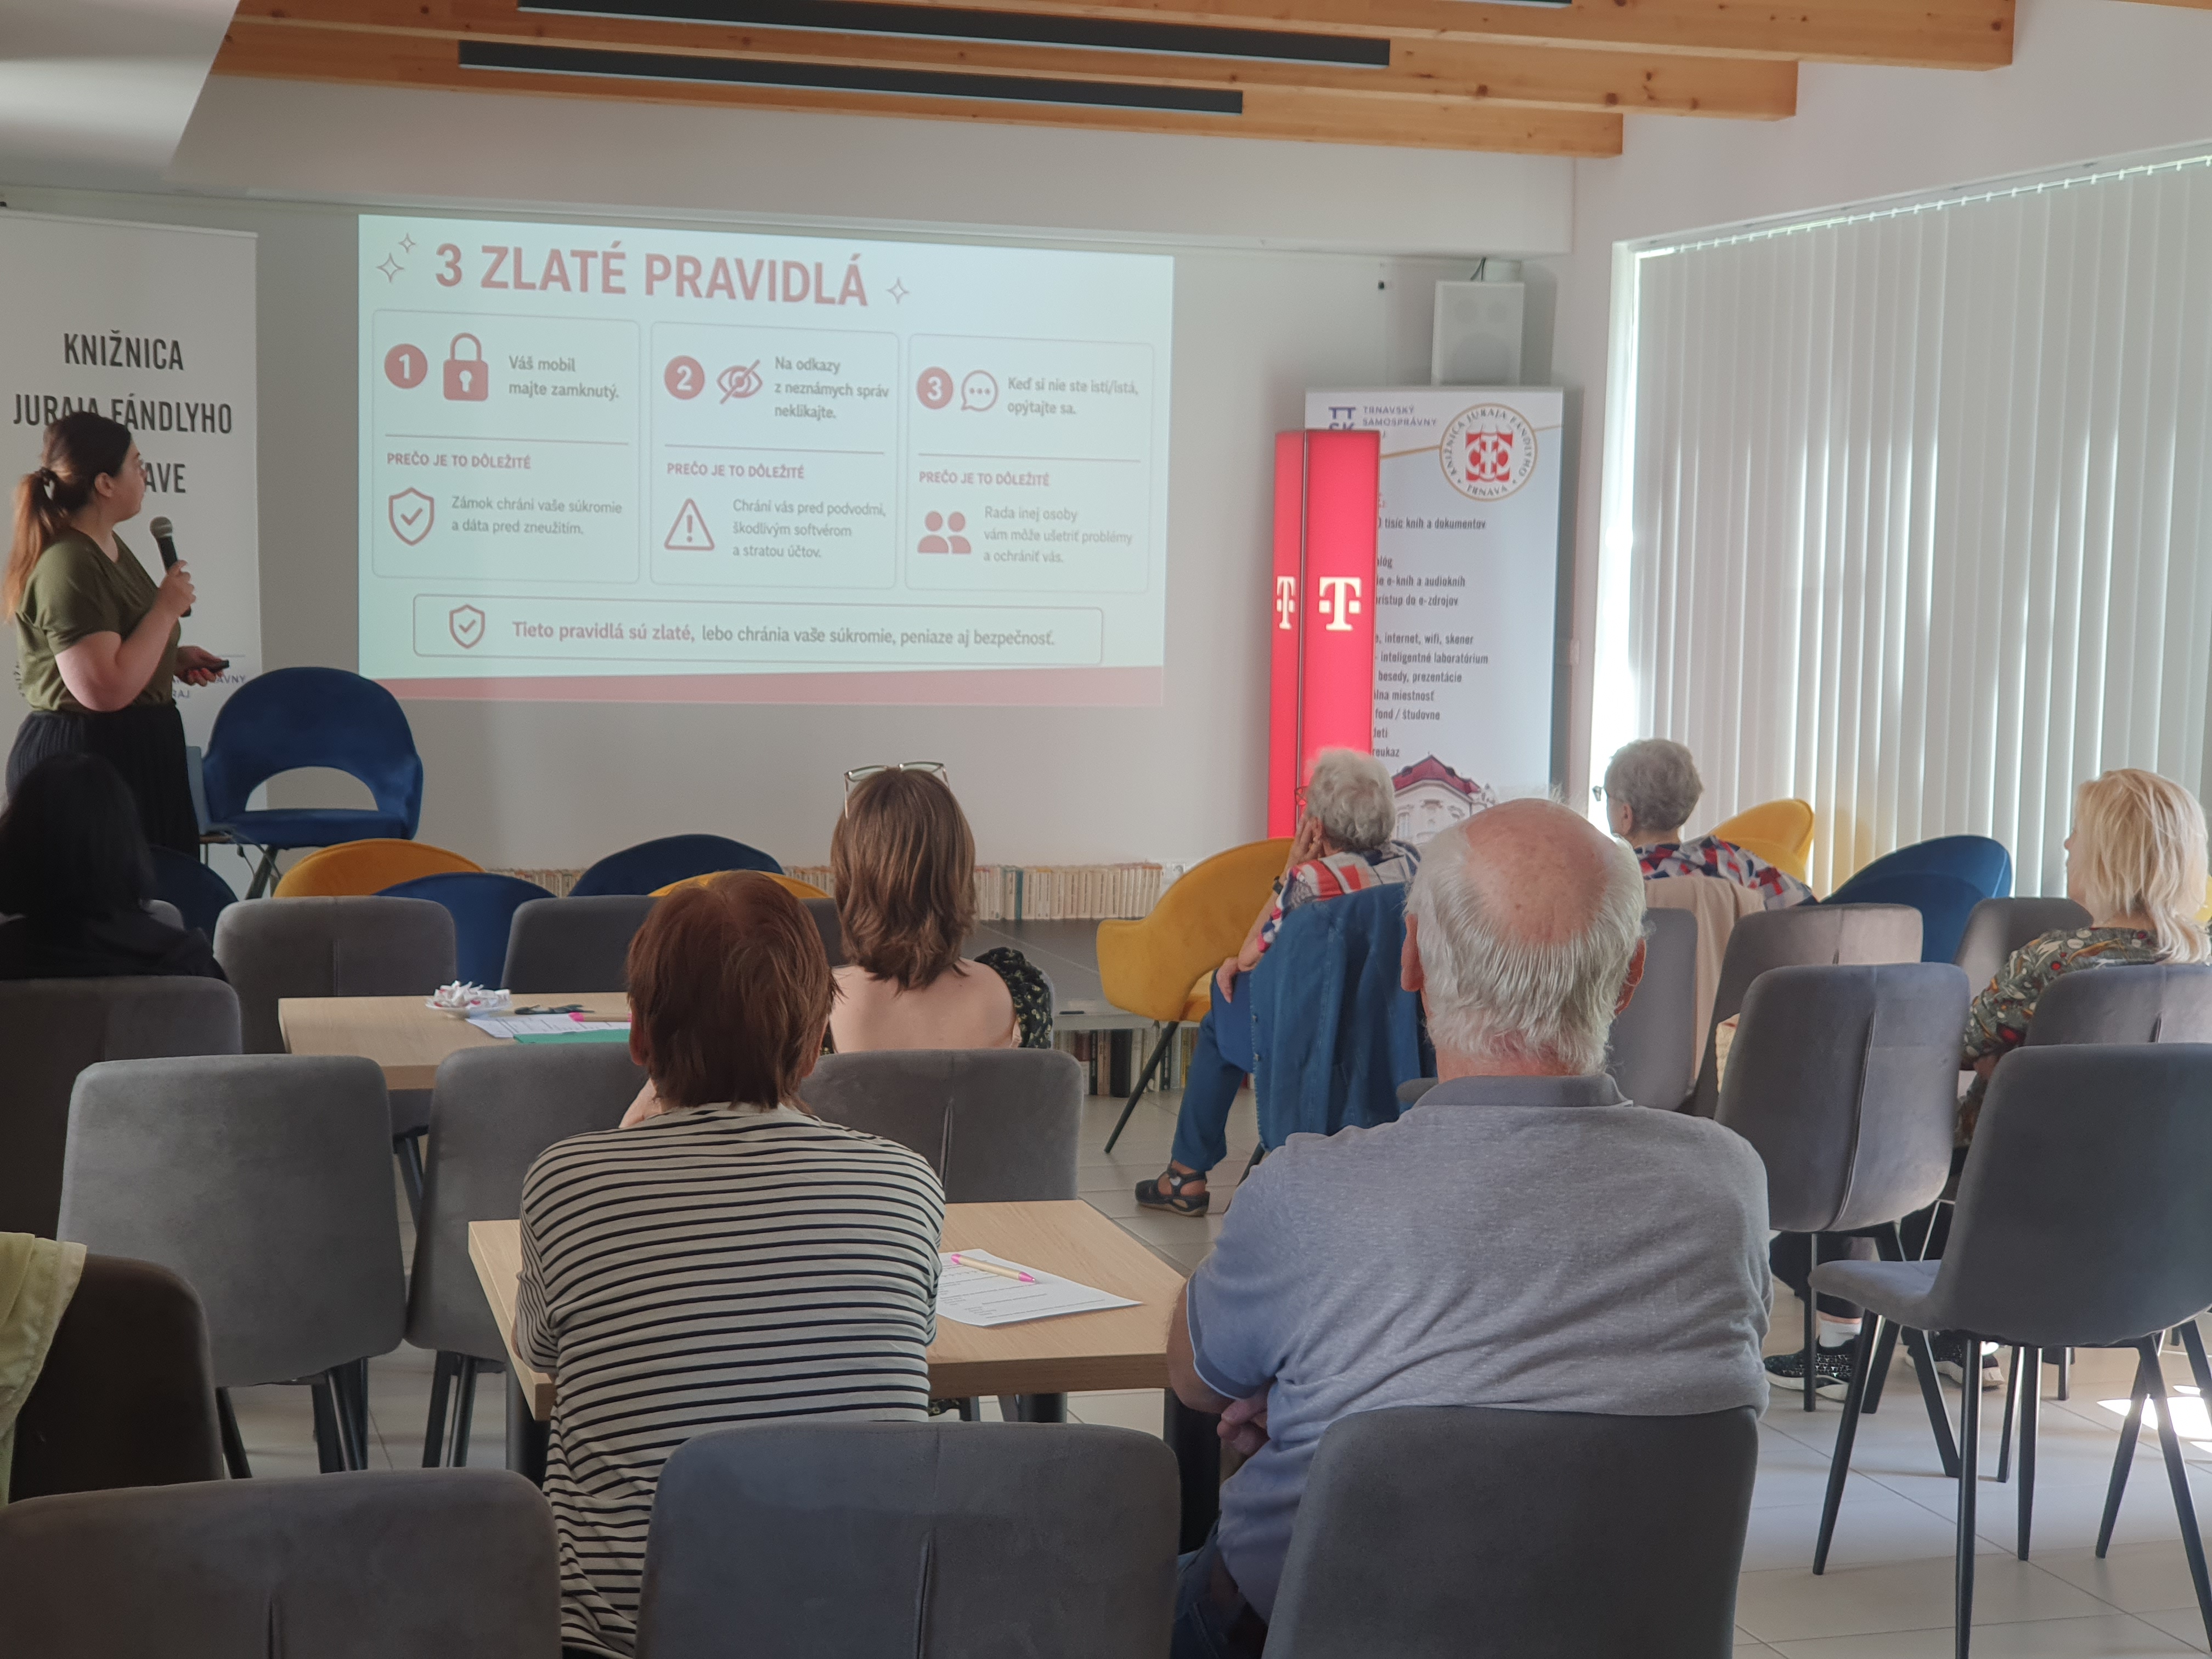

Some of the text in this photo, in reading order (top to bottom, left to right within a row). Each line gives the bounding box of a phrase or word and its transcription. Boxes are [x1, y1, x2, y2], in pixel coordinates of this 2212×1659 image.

[436, 240, 868, 306] 3 ZLATÉ PRAVIDLÁ
[63, 329, 185, 371] KNIŽNICA
[398, 353, 411, 380] 1
[508, 355, 576, 373] Váš mobil
[775, 356, 840, 375] Na odkazy
[676, 365, 692, 391] 2
[1007, 377, 1032, 391] Keď
[1035, 378, 1045, 391] si
[1048, 378, 1066, 391] nie
[1069, 380, 1088, 392] ste
[508, 382, 619, 402] majte zamknutý.
[774, 382, 889, 399] z neznámych správ
[926, 376, 943, 400] 3
[111, 392, 233, 434] FÁNDLYHO
[774, 404, 836, 421] neklikajte.
[1007, 399, 1076, 417] opýtajte sa.
[1363, 404, 1415, 414] TRNAVSKÝ
[1362, 416, 1437, 427] SAMOSPRÁVNY
[387, 451, 531, 469] PREČO JE TO DÔLEŽITÉ
[667, 461, 805, 479] PREČO JE TO DÔLEŽITÉ
[918, 469, 1049, 486] PREČO JE TO DÔLEŽITÉ
[1466, 483, 1508, 496] TRNAVA
[451, 495, 623, 514] Zámok chráni vaše súkromie
[732, 498, 886, 517] Chráni vás pred podvodmi,
[984, 506, 1078, 523] Rada inej osoby
[451, 522, 459, 532] a
[462, 518, 489, 532] dáta
[492, 520, 520, 535] pred
[732, 521, 852, 538] škodlivým softvérom
[1384, 517, 1403, 529] tisíc
[1426, 520, 1432, 529] a
[1434, 517, 1487, 530] dokumentov
[984, 527, 1132, 546] vám môže ušetriť problémy
[732, 545, 822, 558] a stratou účtov.
[983, 549, 1064, 563] a ochrániť vás.
[1417, 578, 1422, 587] a
[1276, 575, 1295, 630] T
[1318, 576, 1362, 631] T
[1406, 594, 1416, 606] do
[512, 620, 1055, 648] Tieto pravidlá sú zlaté, lebo chránia vaše súkromie, peniaze aj bezpečnosť.
[1384, 632, 1421, 646] internet,
[1445, 632, 1474, 645] skener
[1380, 651, 1489, 665] inteligentné laboratórium
[1378, 670, 1463, 684] besedy, prezentácie
[1392, 689, 1435, 702] miestnosť
[1375, 708, 1393, 720] fond
[1372, 747, 1400, 758] reukaz
